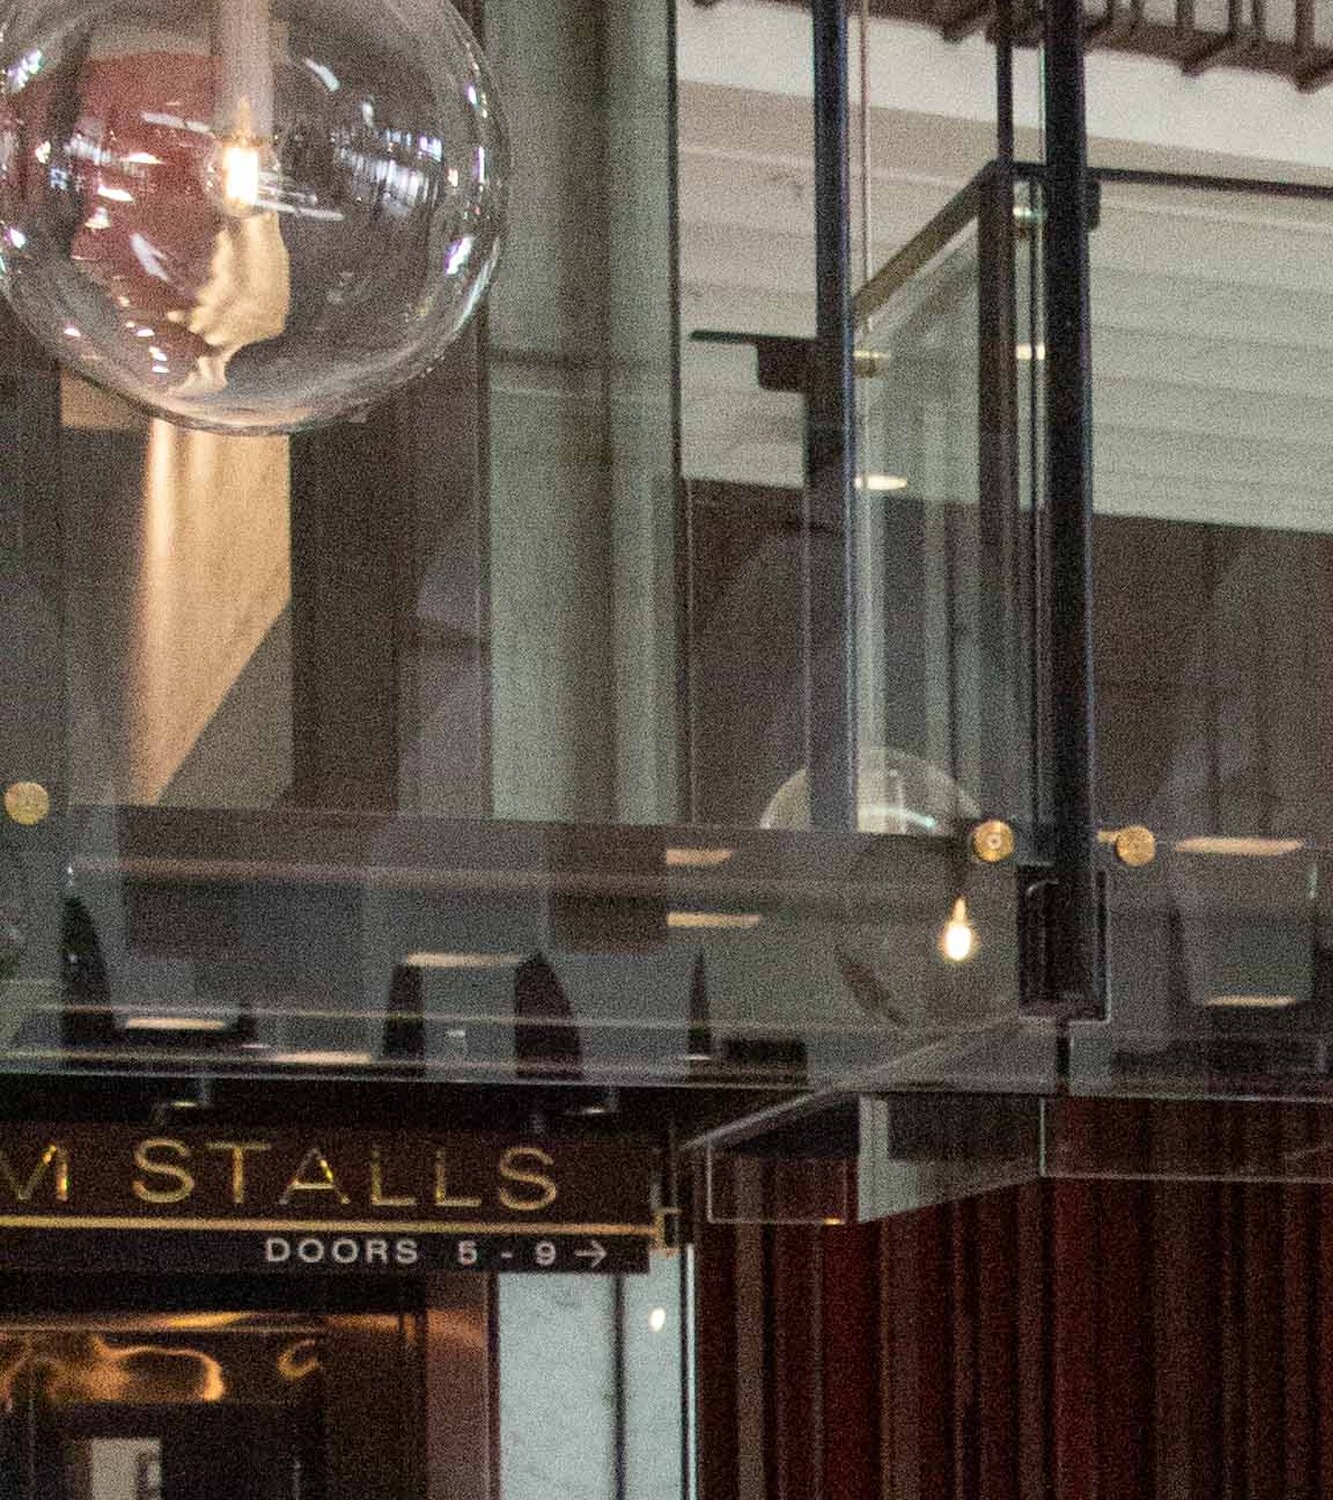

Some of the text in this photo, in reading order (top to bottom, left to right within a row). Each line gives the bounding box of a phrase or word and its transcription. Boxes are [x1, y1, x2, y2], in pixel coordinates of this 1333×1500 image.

[132, 1137, 558, 1210] STALLS
[264, 1237, 420, 1264] DOORS
[535, 1241, 557, 1265] 9
